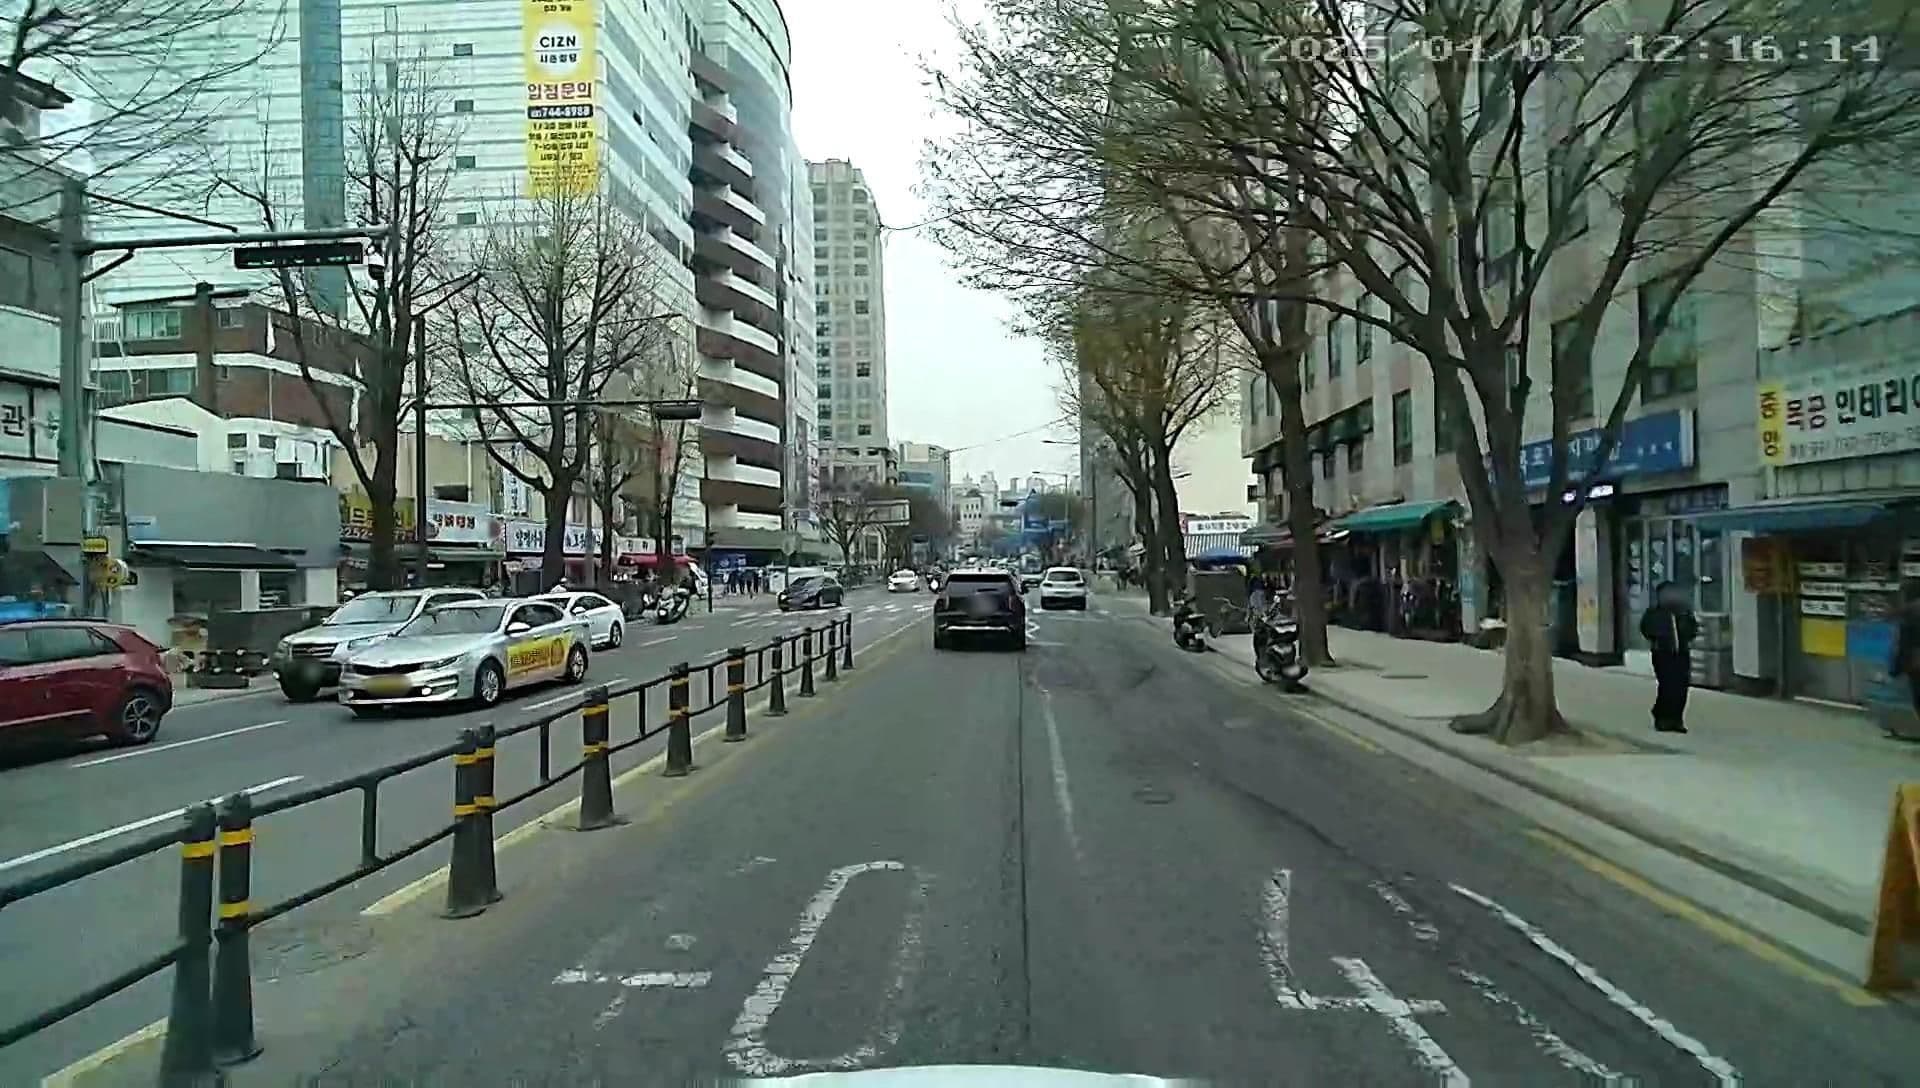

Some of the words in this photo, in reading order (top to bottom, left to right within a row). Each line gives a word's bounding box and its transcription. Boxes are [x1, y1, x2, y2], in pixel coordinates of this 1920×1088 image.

[540, 36, 576, 48] CIZN
[528, 82, 592, 100] 입점문의
[1759, 391, 1779, 457] 중앙
[1786, 394, 1827, 430] 목공
